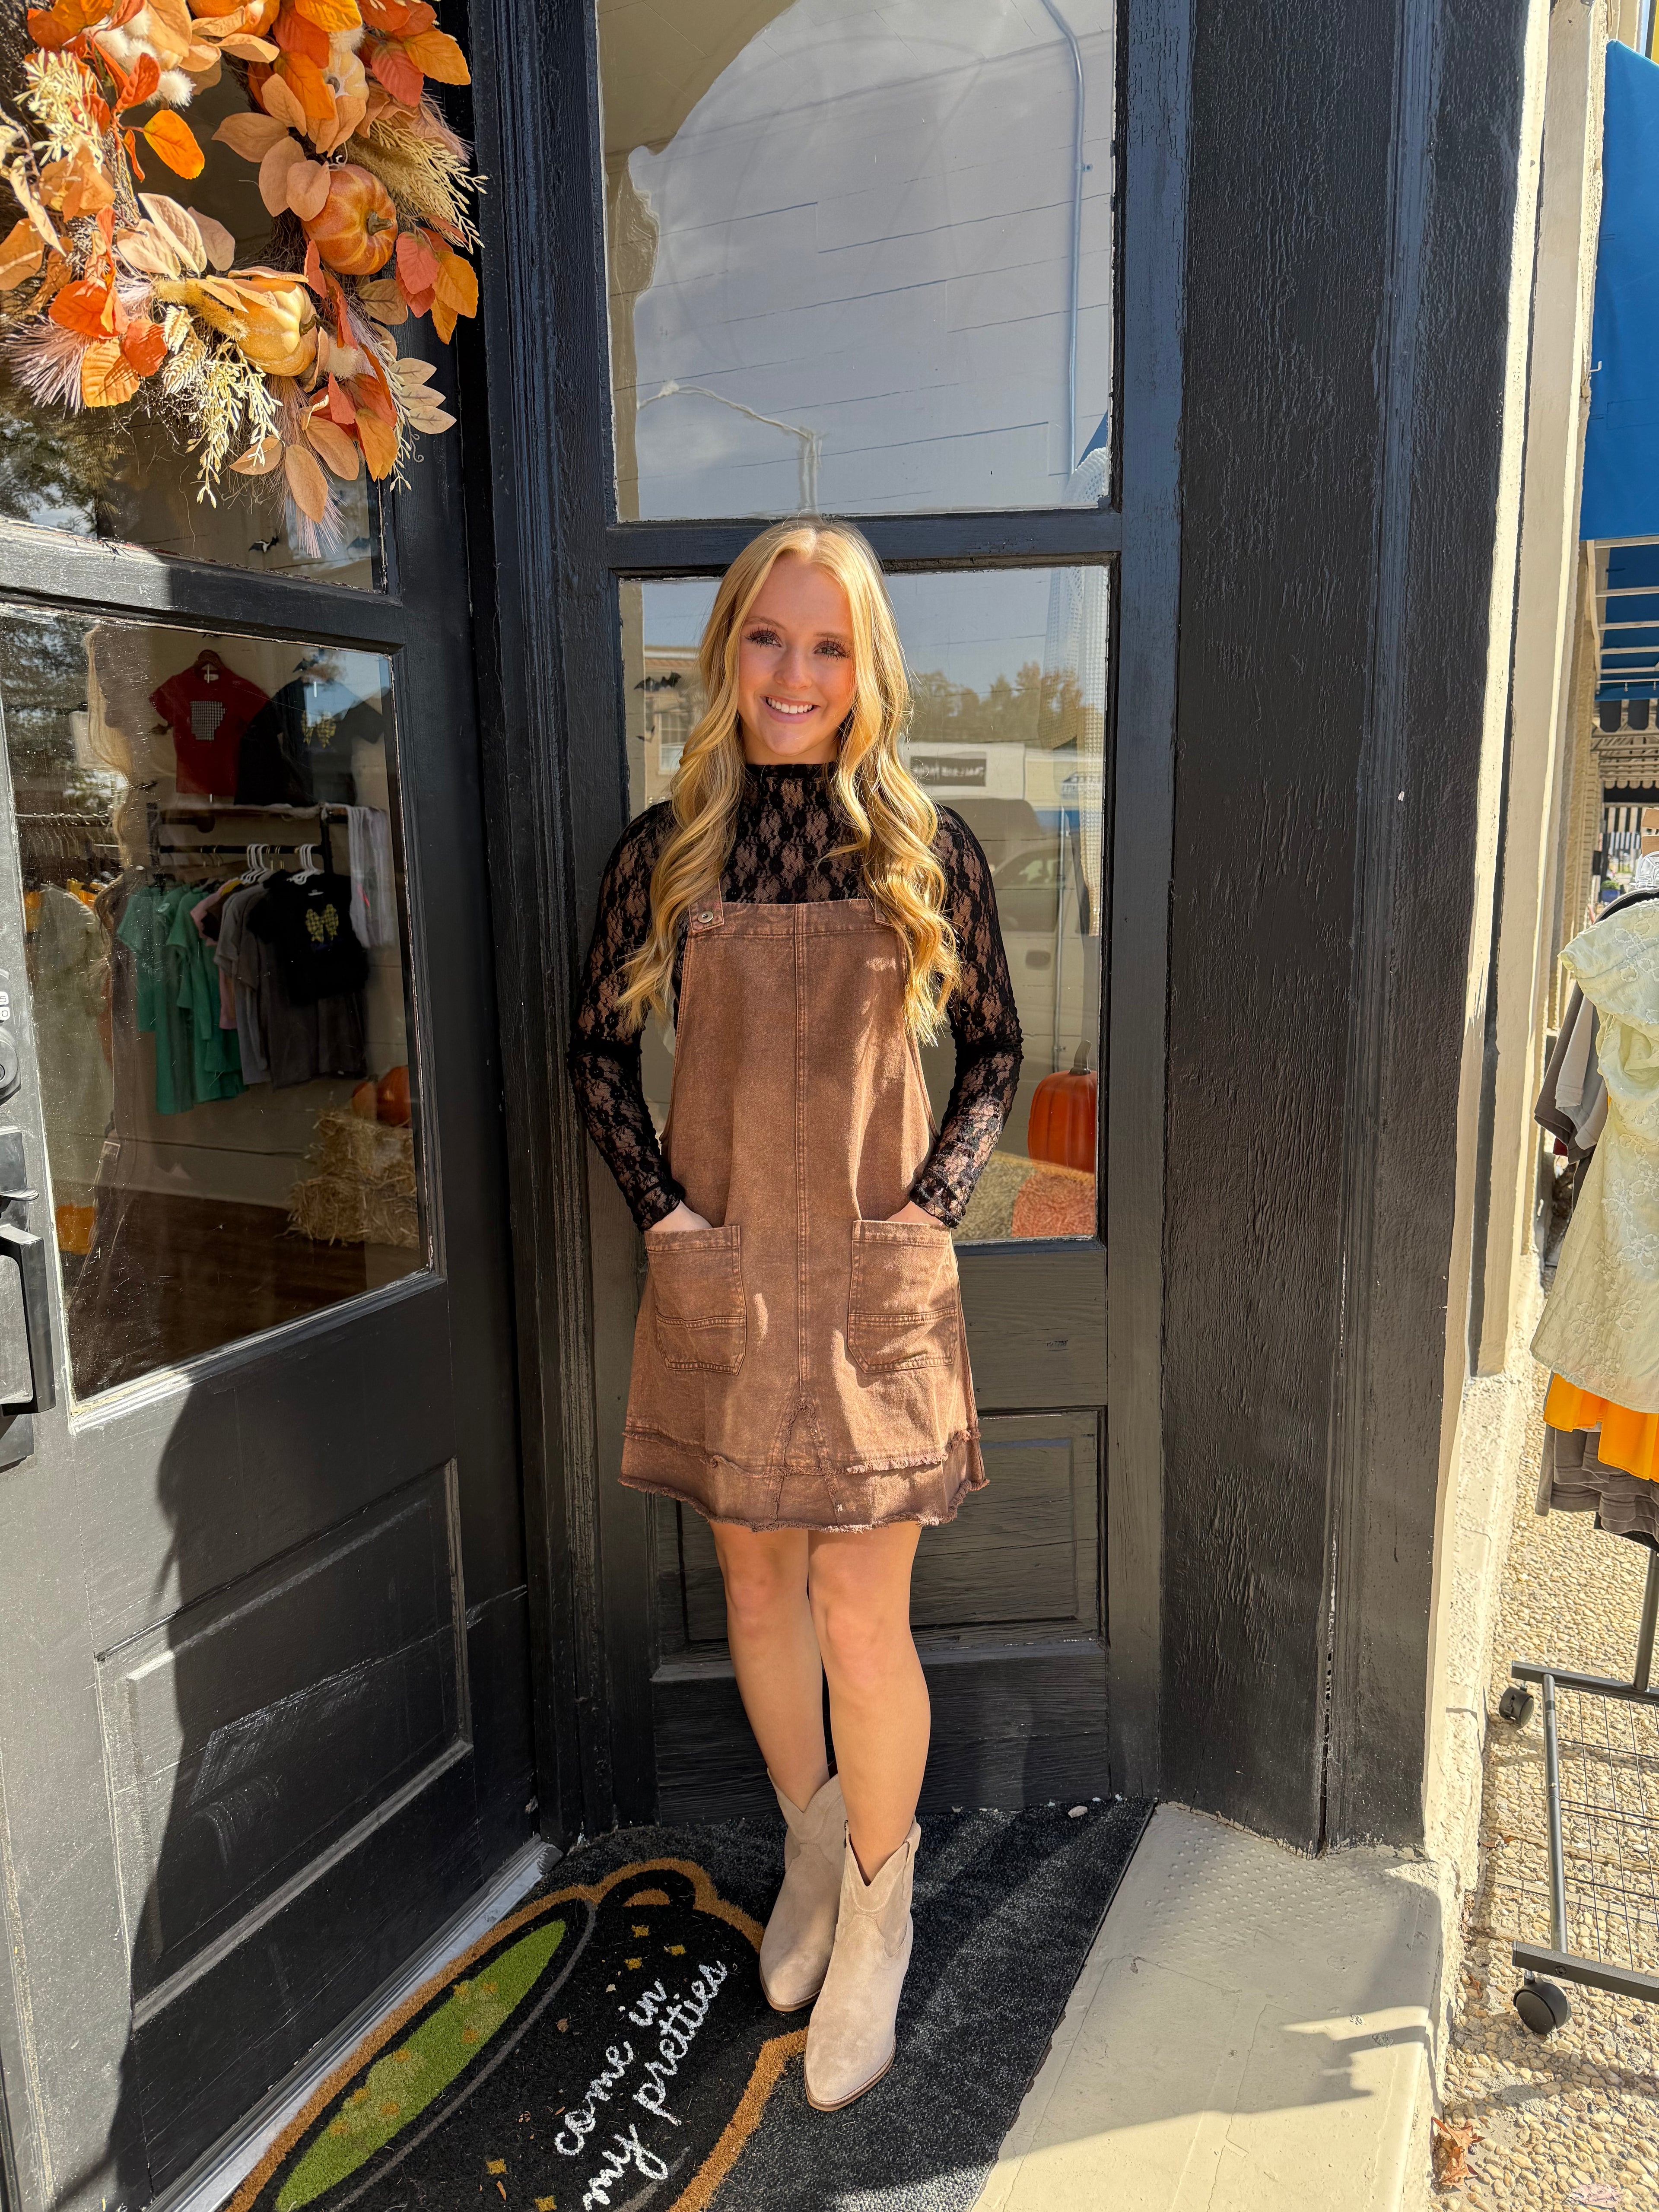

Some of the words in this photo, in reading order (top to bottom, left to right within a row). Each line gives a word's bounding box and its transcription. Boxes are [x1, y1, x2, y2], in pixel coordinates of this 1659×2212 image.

[554, 2041, 634, 2156] come
[618, 1978, 667, 2027] in
[582, 2123, 668, 2211] my
[632, 1961, 728, 2126] pretties
